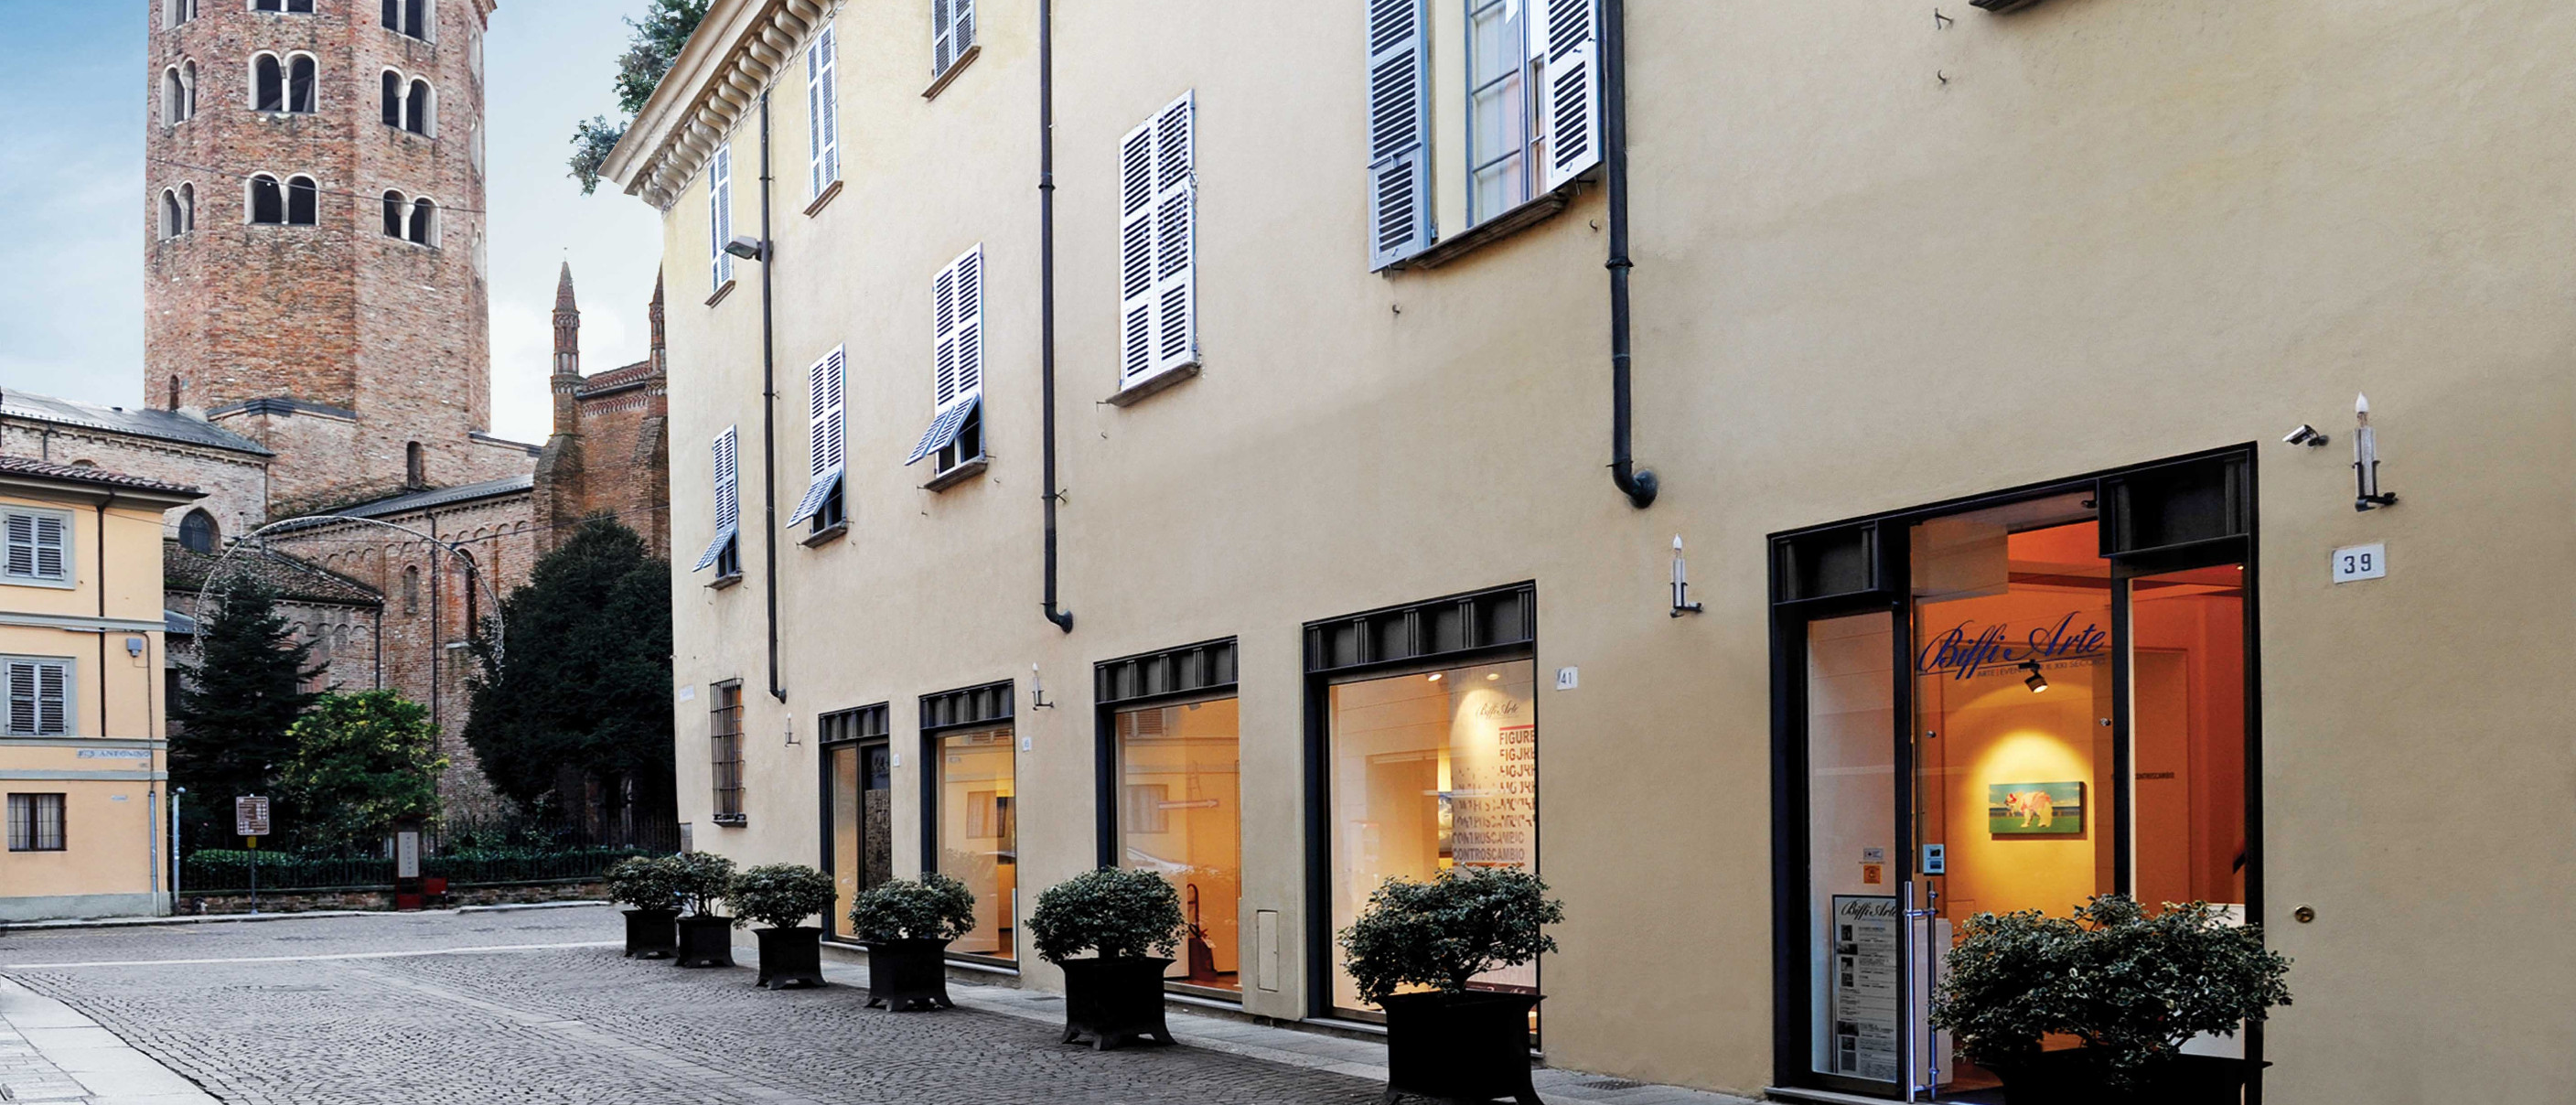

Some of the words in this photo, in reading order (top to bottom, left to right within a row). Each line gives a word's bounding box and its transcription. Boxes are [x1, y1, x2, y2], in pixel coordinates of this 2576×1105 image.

[2344, 552, 2372, 574] 39
[1917, 620, 2008, 680] Biffi
[2002, 610, 2107, 661] Arte
[1499, 729, 1535, 746] FIGURE
[1452, 847, 1525, 862] CONTROSCAMBIO
[1841, 899, 1873, 921] Biffi
